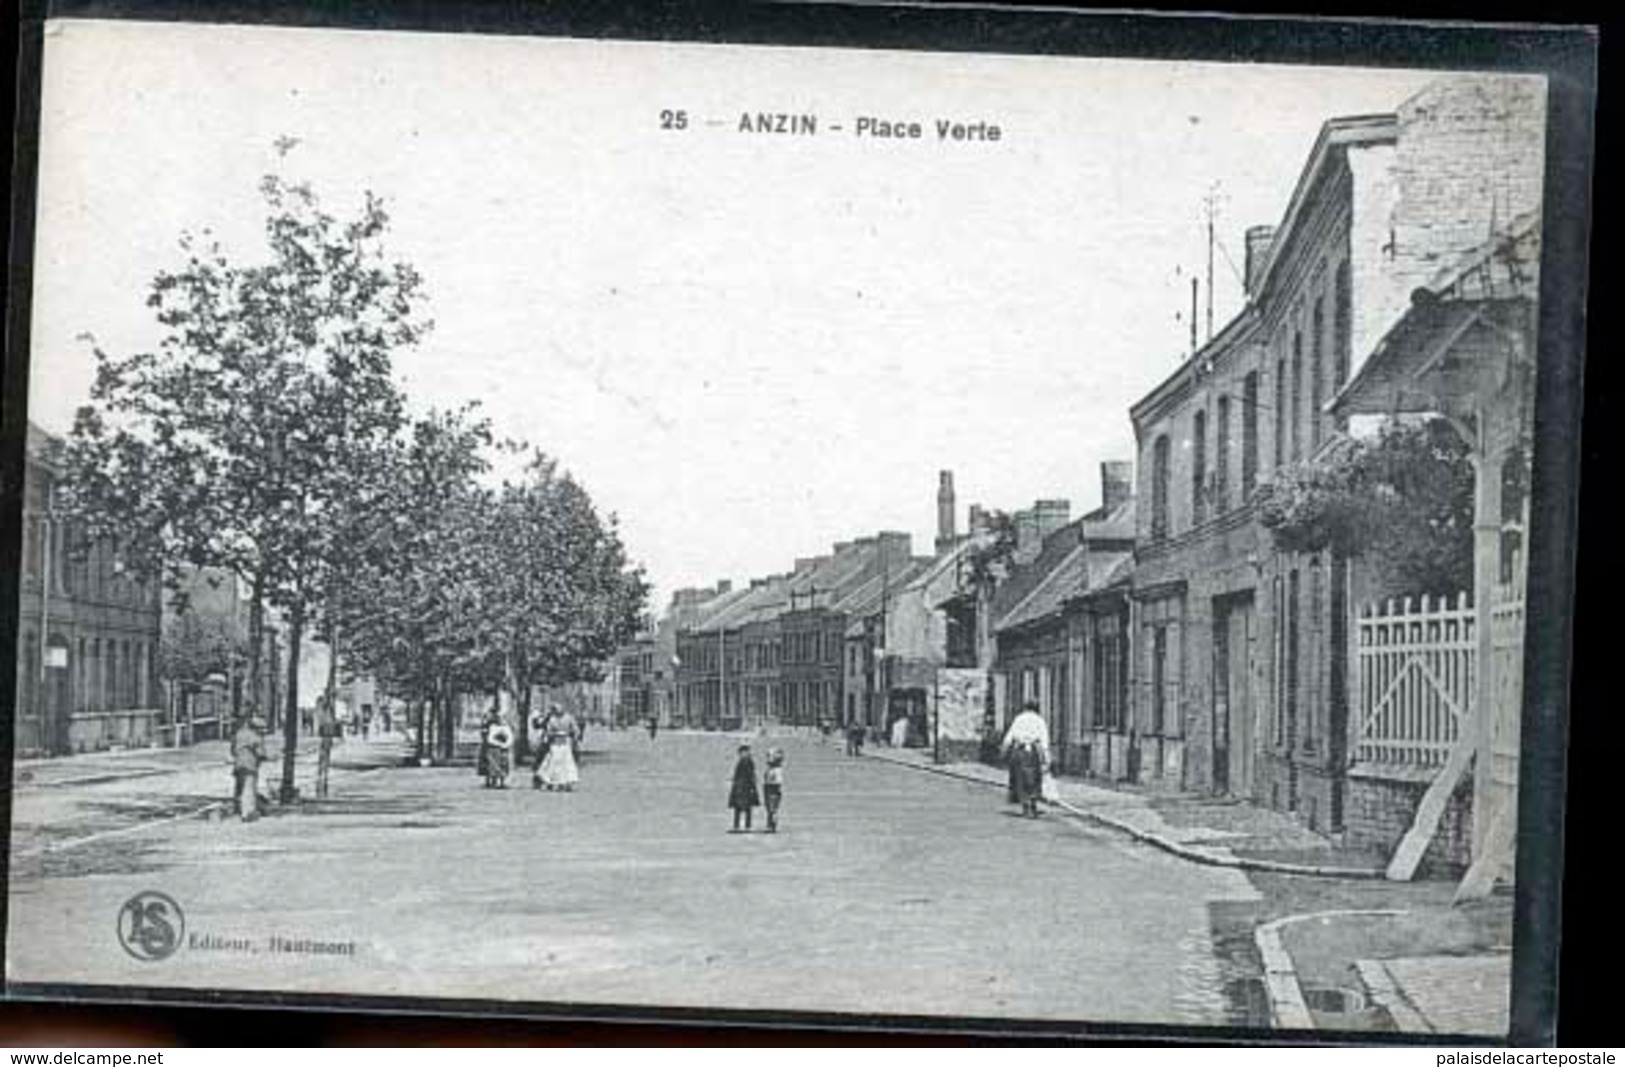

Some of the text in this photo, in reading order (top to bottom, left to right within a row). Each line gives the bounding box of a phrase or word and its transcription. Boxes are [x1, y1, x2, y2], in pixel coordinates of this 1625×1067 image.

[659, 109, 689, 131] 25
[738, 112, 817, 136] ANZIN
[856, 117, 922, 139] Place
[936, 119, 1002, 142] Verte
